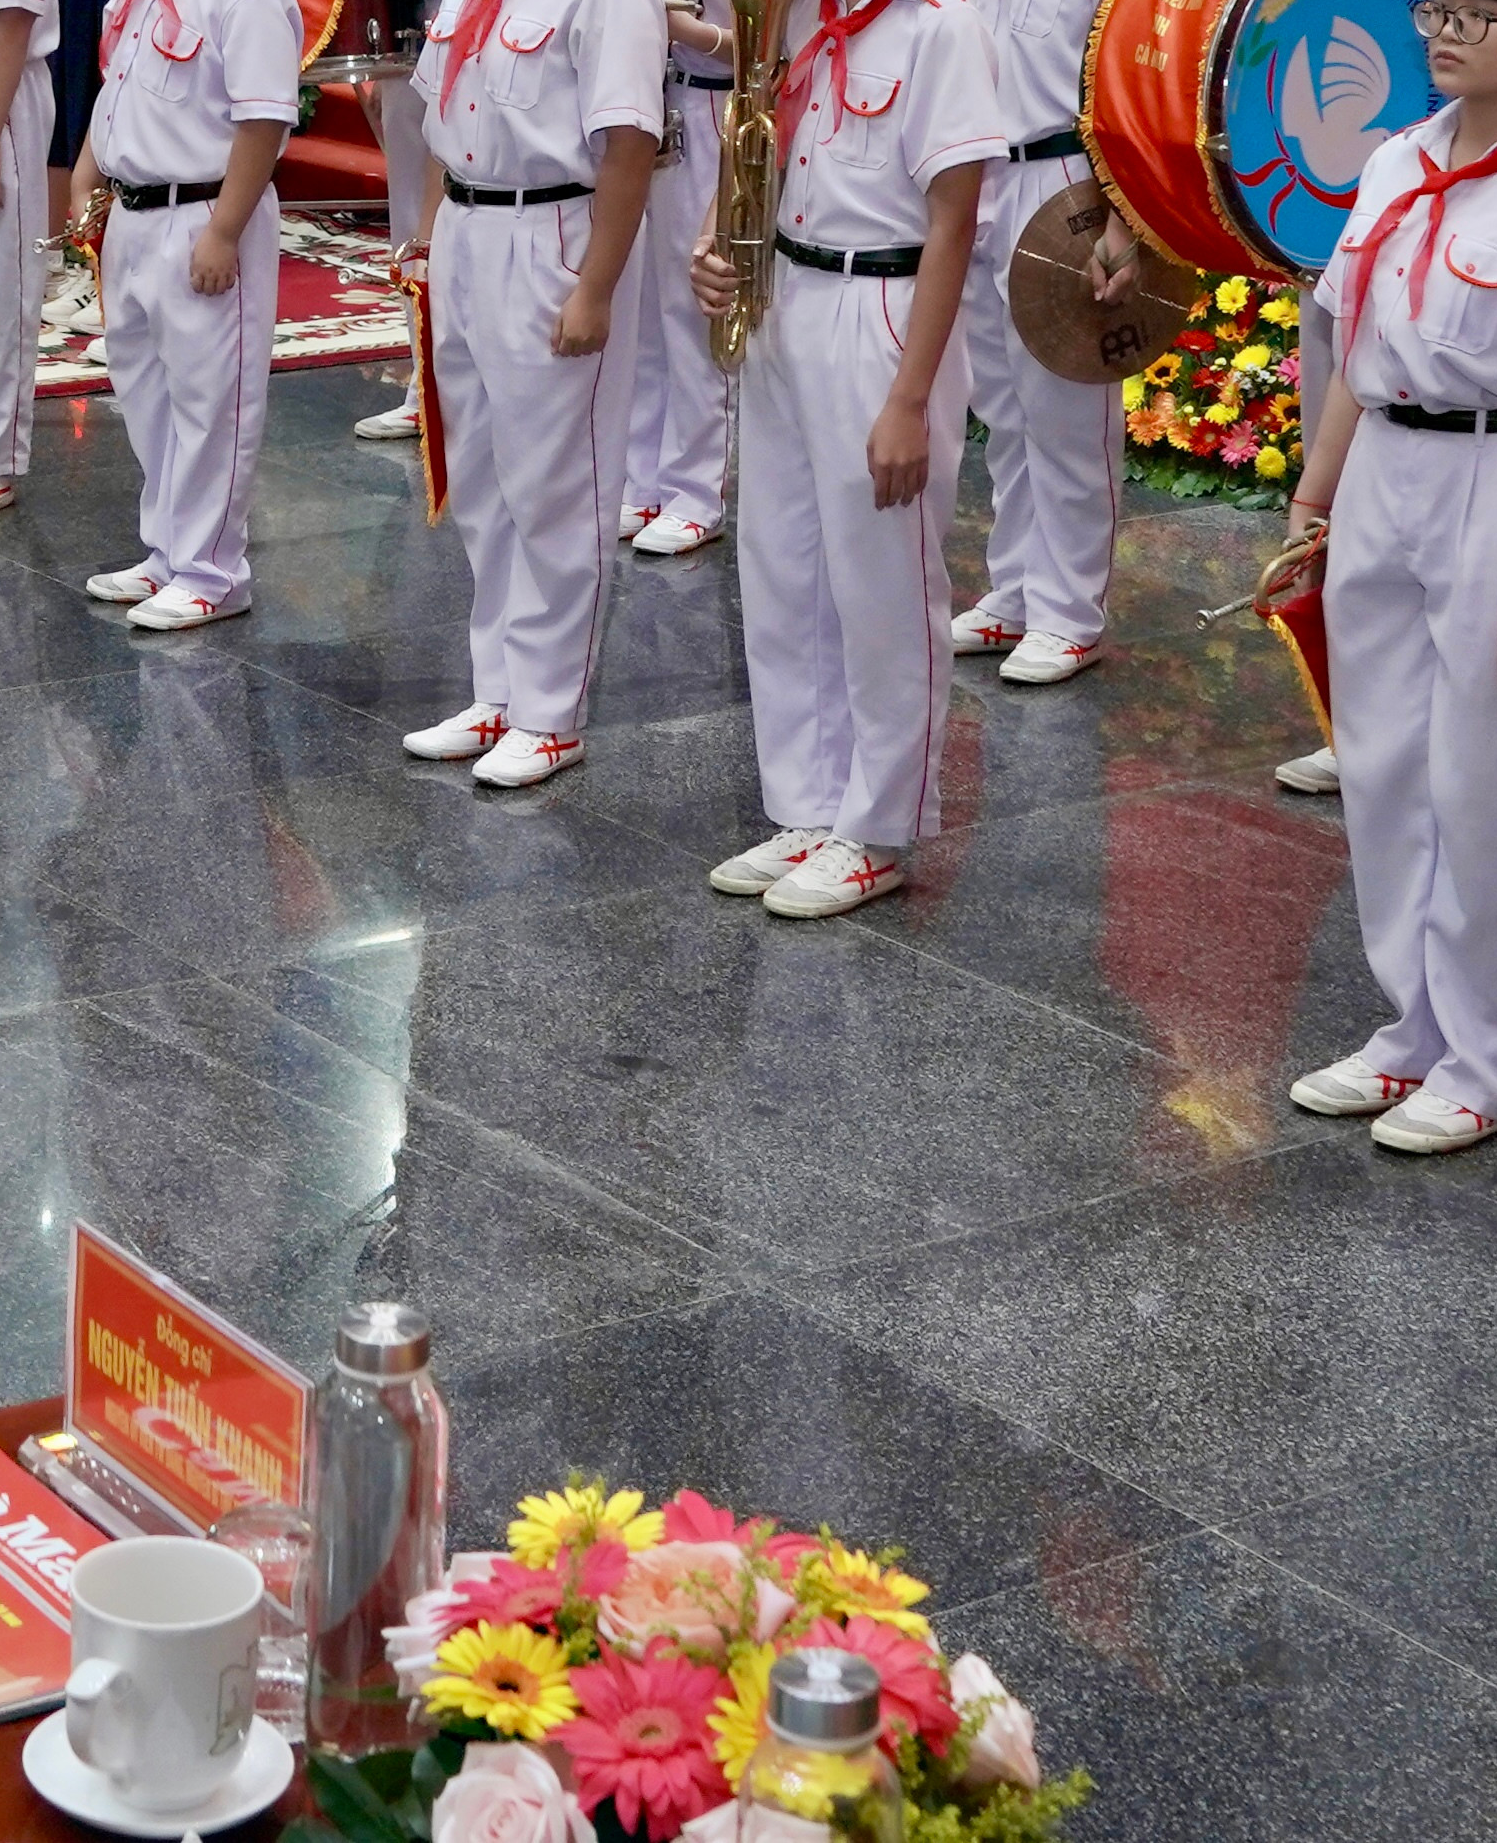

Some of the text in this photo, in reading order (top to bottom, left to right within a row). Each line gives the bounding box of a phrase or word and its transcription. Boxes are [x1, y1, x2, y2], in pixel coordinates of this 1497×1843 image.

[156, 1313, 190, 1369] Đồng
[88, 1318, 160, 1409] NGUYỄN
[216, 1415, 283, 1505] KHANH
